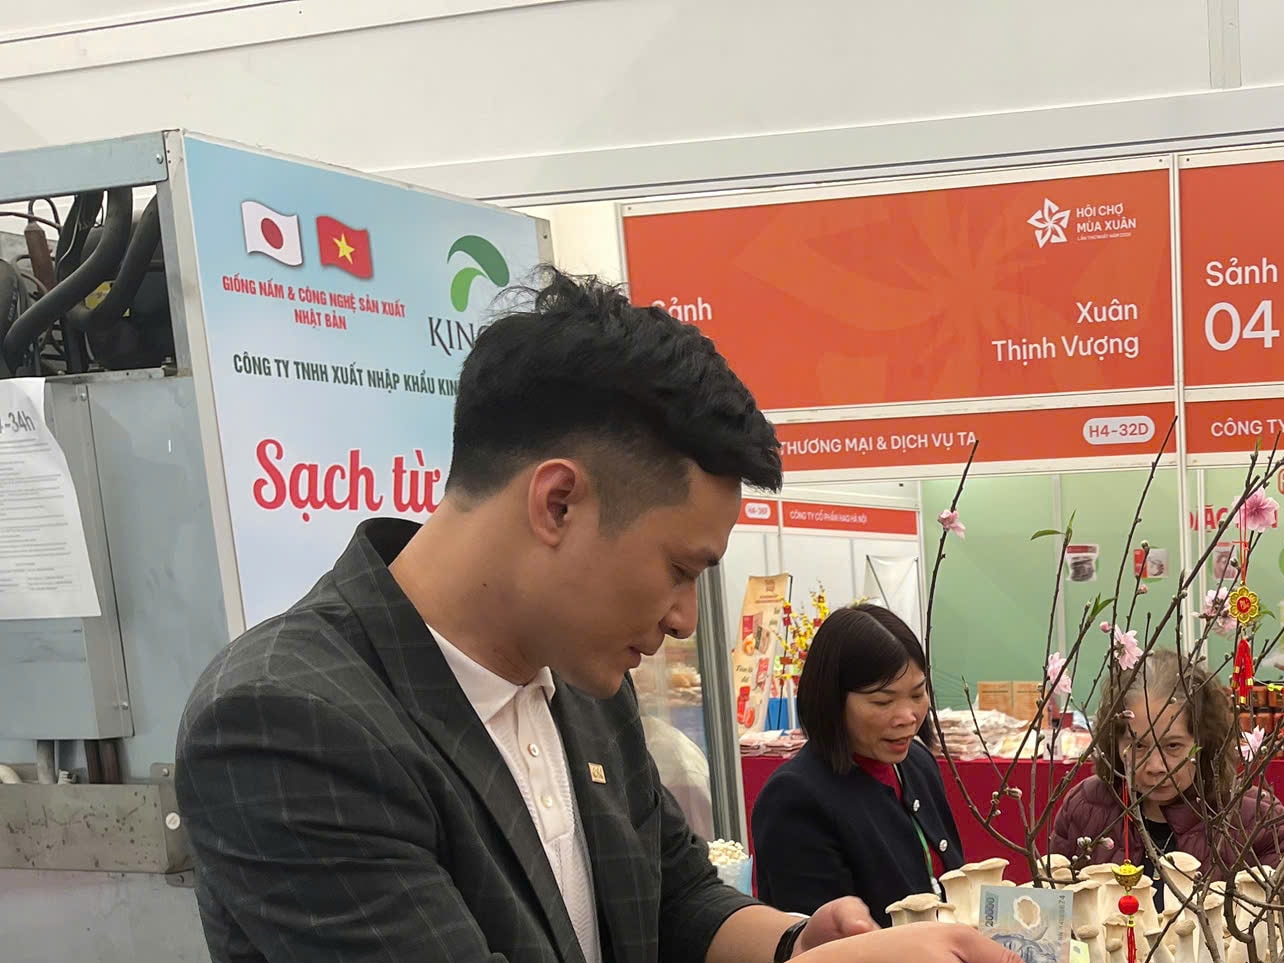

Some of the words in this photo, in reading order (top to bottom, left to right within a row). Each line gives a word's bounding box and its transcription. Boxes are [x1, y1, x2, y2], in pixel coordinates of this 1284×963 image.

[1076, 220, 1102, 233] MÙA
[1104, 216, 1137, 231] XUÂN
[1204, 256, 1279, 288] Sảnh
[222, 272, 256, 295] GIỐNG
[259, 278, 285, 300] NẤM
[287, 286, 296, 301] &
[298, 285, 327, 306] CÔNG
[329, 290, 356, 313] NGHỆ
[359, 293, 379, 314] SẢN
[381, 299, 406, 318] XUẤT
[294, 308, 322, 329] NHẬT
[325, 310, 347, 330] BẢN
[1076, 299, 1138, 325] Xuân
[1204, 299, 1281, 352] 04
[991, 337, 1056, 367] Thịnh
[1061, 333, 1140, 363] Vượng
[233, 351, 272, 377] CÔNG
[274, 358, 290, 379] TY
[293, 360, 329, 383] TNHH
[331, 361, 364, 387] XUẤT
[367, 368, 401, 394] NHẬP
[403, 369, 436, 396] KHẨU
[1088, 421, 1149, 440] H4-32D
[1210, 412, 1263, 438] CÔNG
[845, 437, 873, 455] MẠI
[876, 436, 887, 450] &
[891, 433, 928, 453] DỊCH
[931, 432, 953, 451] VỤ
[957, 431, 977, 446] TA
[252, 437, 384, 523] Sạch
[391, 449, 442, 514] từ
